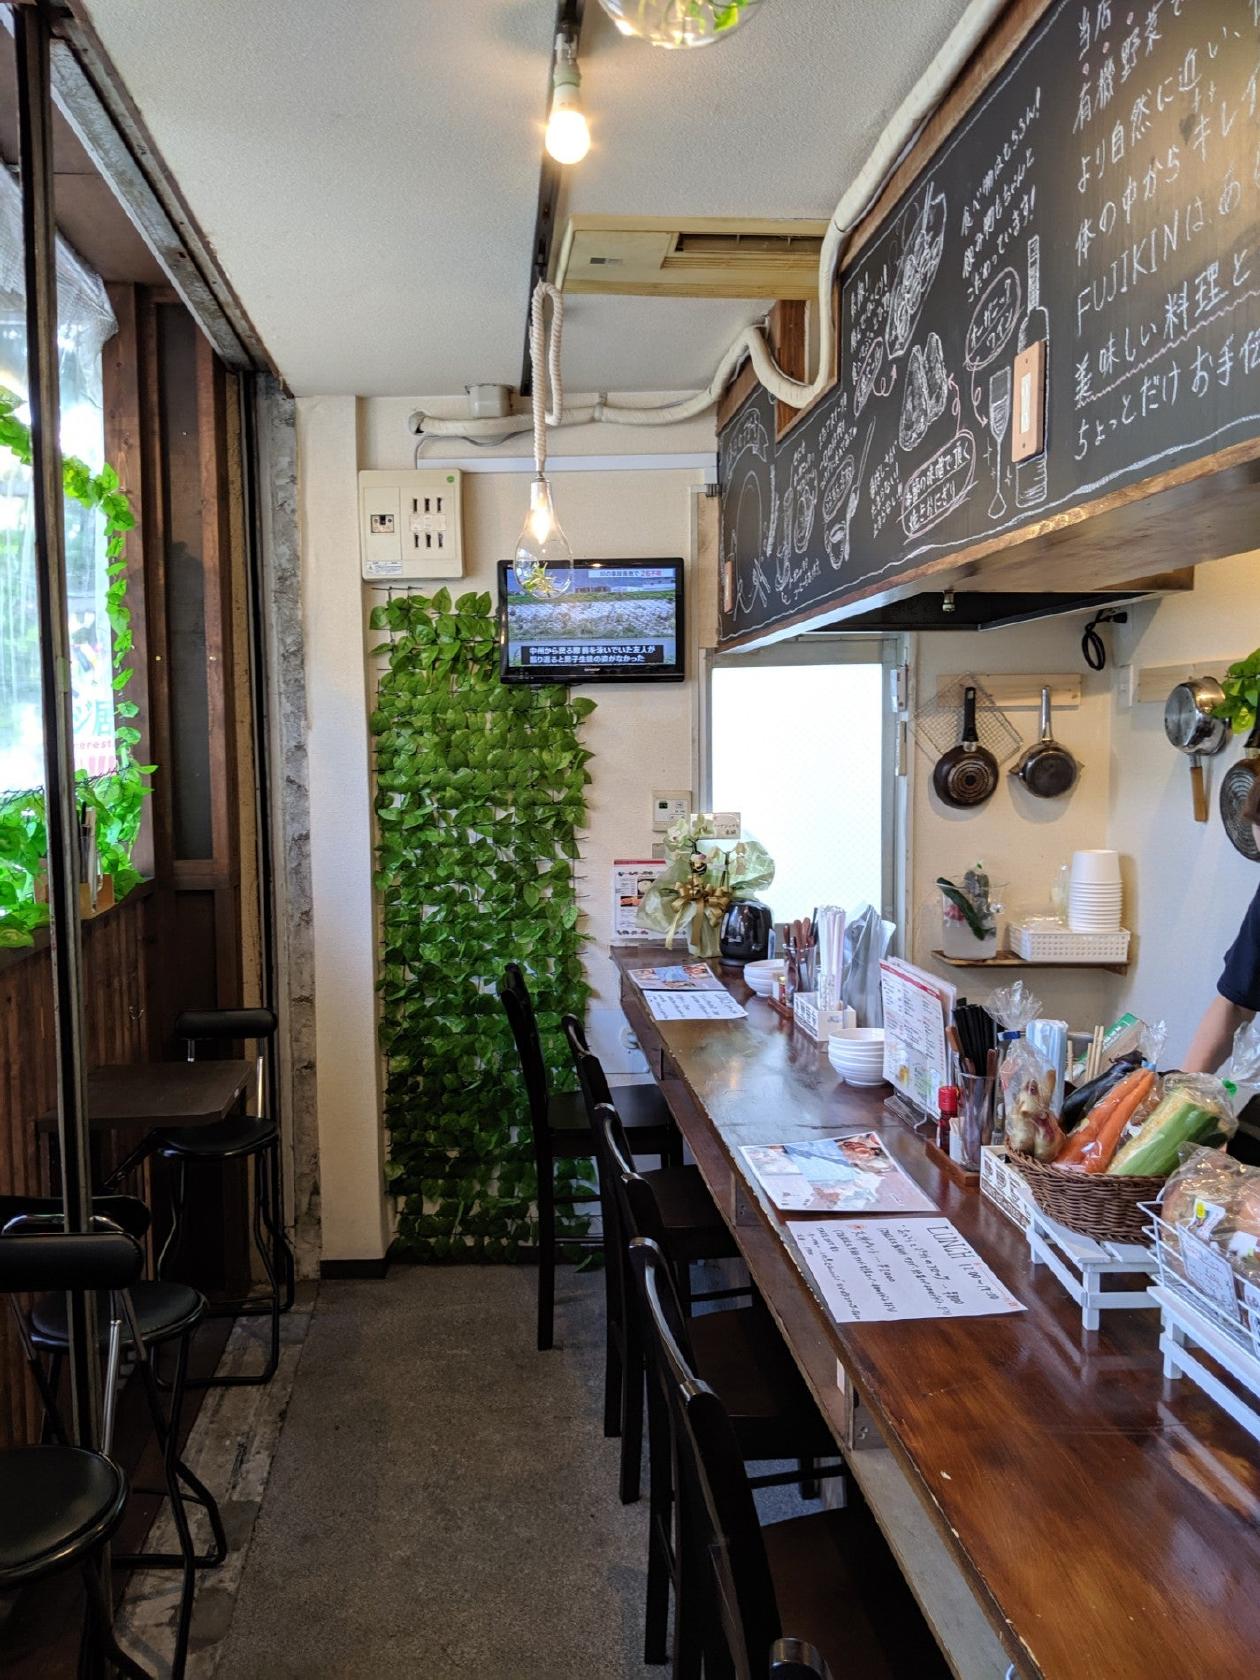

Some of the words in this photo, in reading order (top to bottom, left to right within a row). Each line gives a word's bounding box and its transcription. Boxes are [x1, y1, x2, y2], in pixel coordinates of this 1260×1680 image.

[1075, 249, 1250, 402] 美味しい料理と
[926, 1225, 976, 1259] LUNCH
